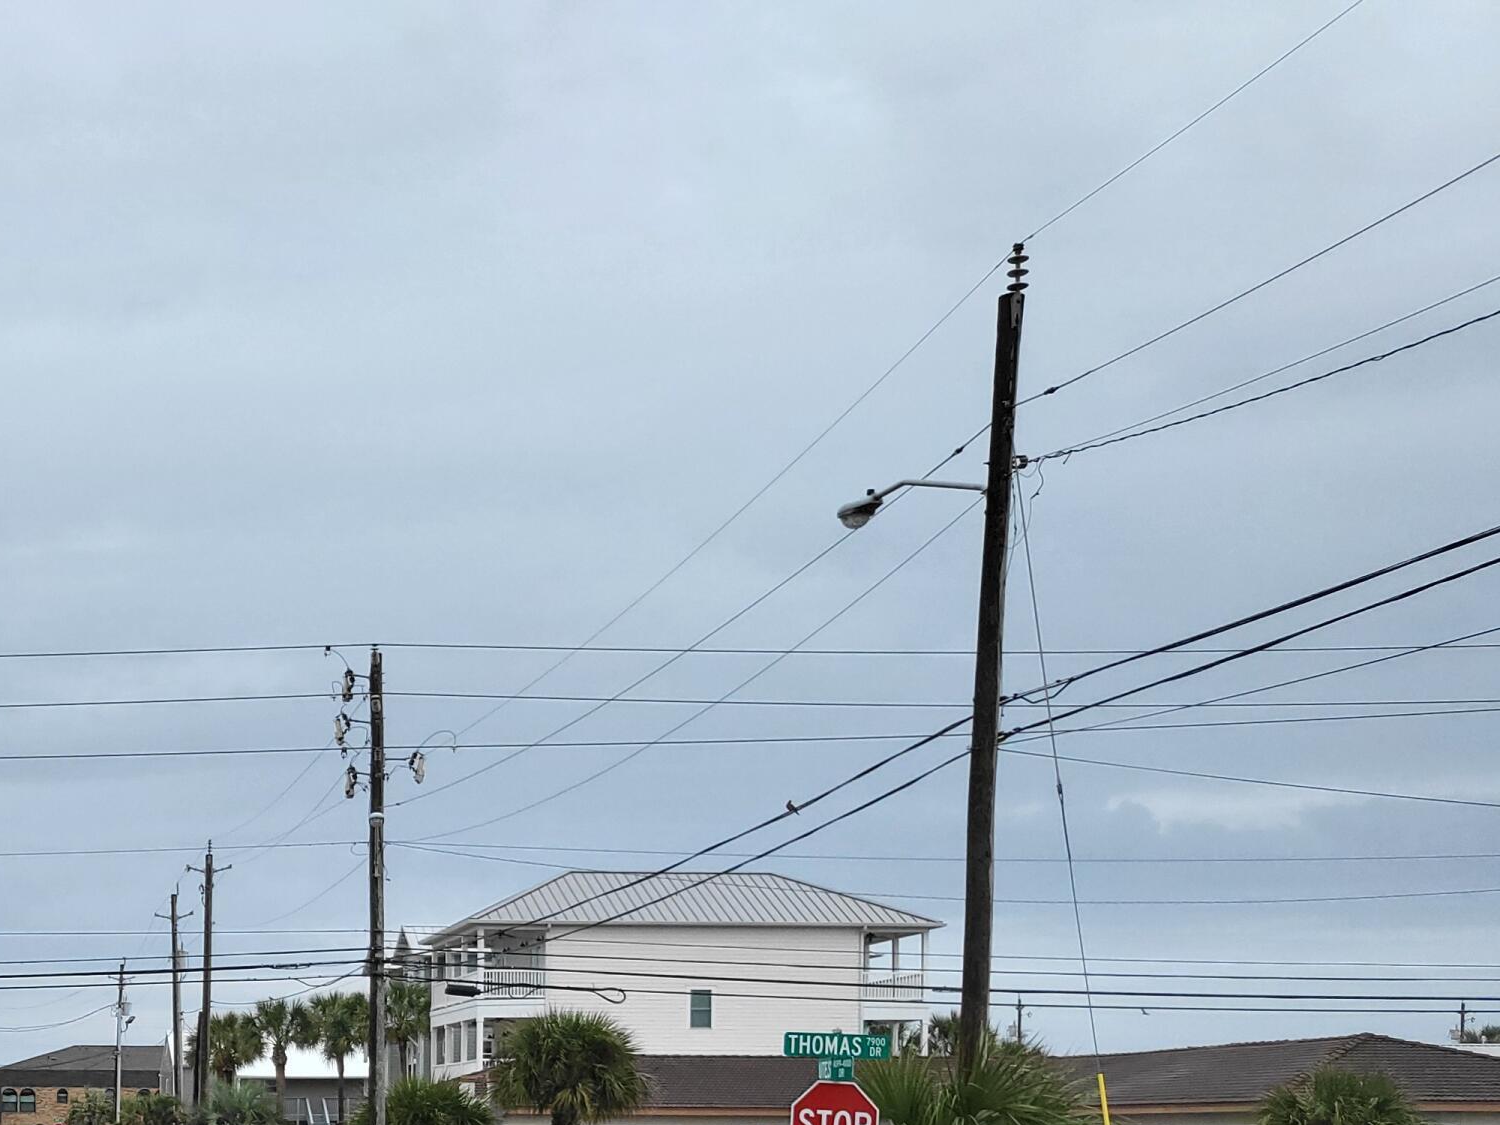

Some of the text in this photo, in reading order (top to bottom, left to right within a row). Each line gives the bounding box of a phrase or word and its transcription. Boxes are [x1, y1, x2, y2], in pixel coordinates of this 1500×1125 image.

[788, 1034, 862, 1056] THOMAS
[866, 1037, 886, 1047] 7900
[869, 1047, 882, 1057] DR
